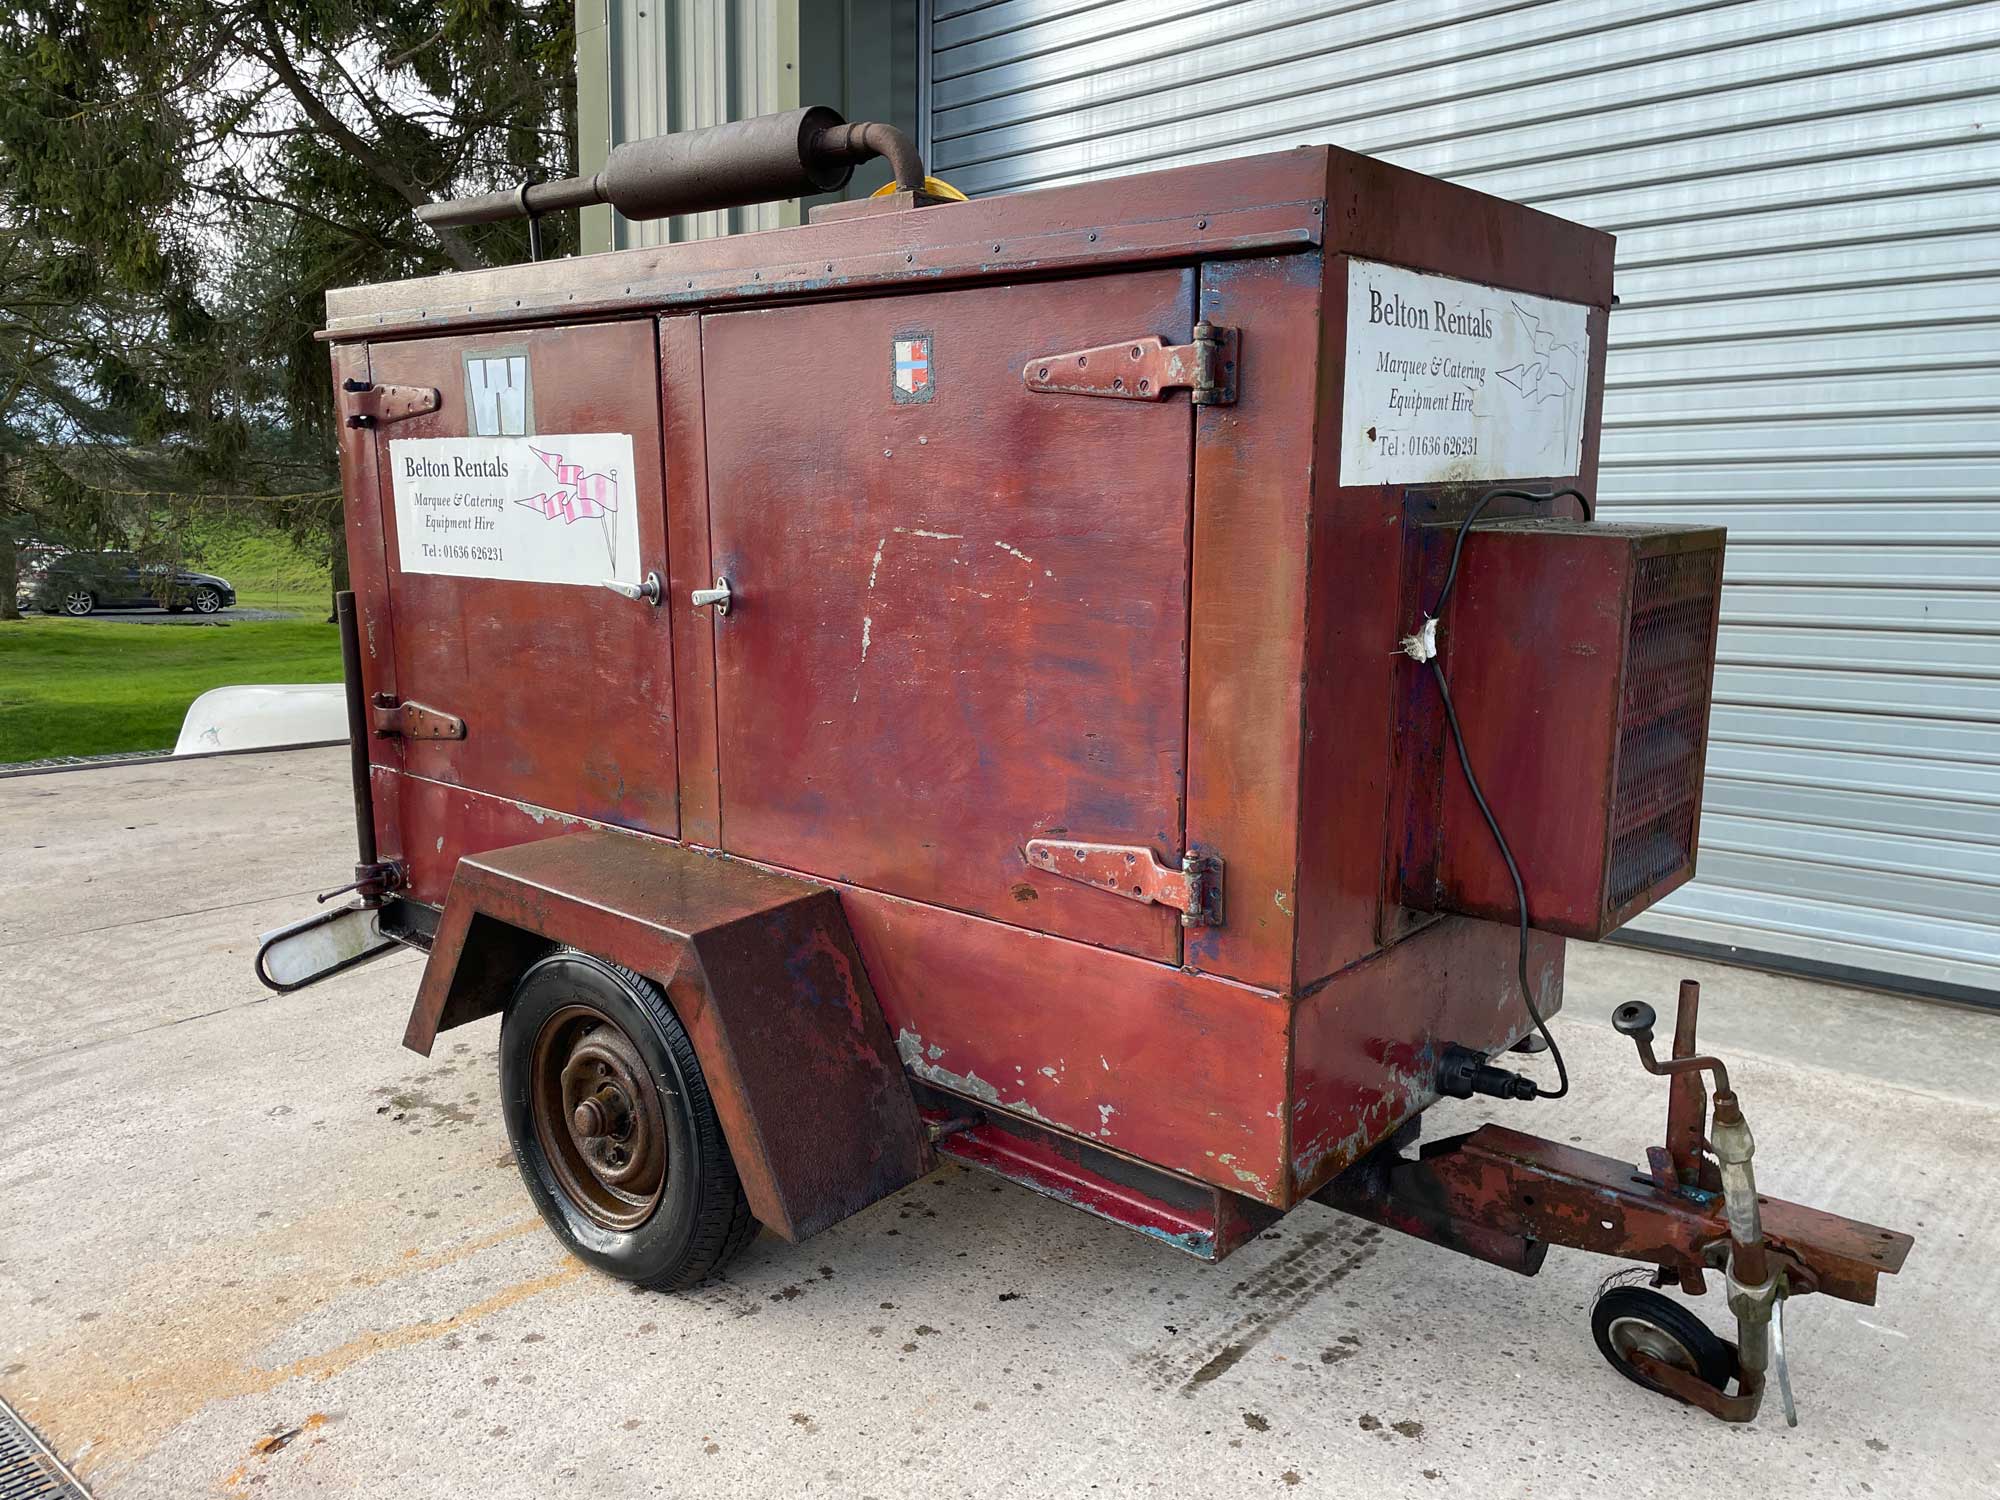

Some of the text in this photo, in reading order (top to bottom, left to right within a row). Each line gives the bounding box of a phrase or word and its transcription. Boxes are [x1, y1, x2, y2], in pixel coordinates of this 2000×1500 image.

[1368, 289, 1493, 339] Belton Rentals
[1375, 351, 1487, 388] Marquee & Catering
[1388, 388, 1474, 417] Equipment Hire
[1408, 435, 1442, 457] 01636
[1443, 435, 1479, 456] 626231
[404, 455, 509, 478] Belton Rentals
[414, 492, 505, 513] Marquee & Catering
[425, 514, 495, 533] Equipment Hire
[443, 544, 470, 560] 01636
[471, 545, 504, 561] 626231
